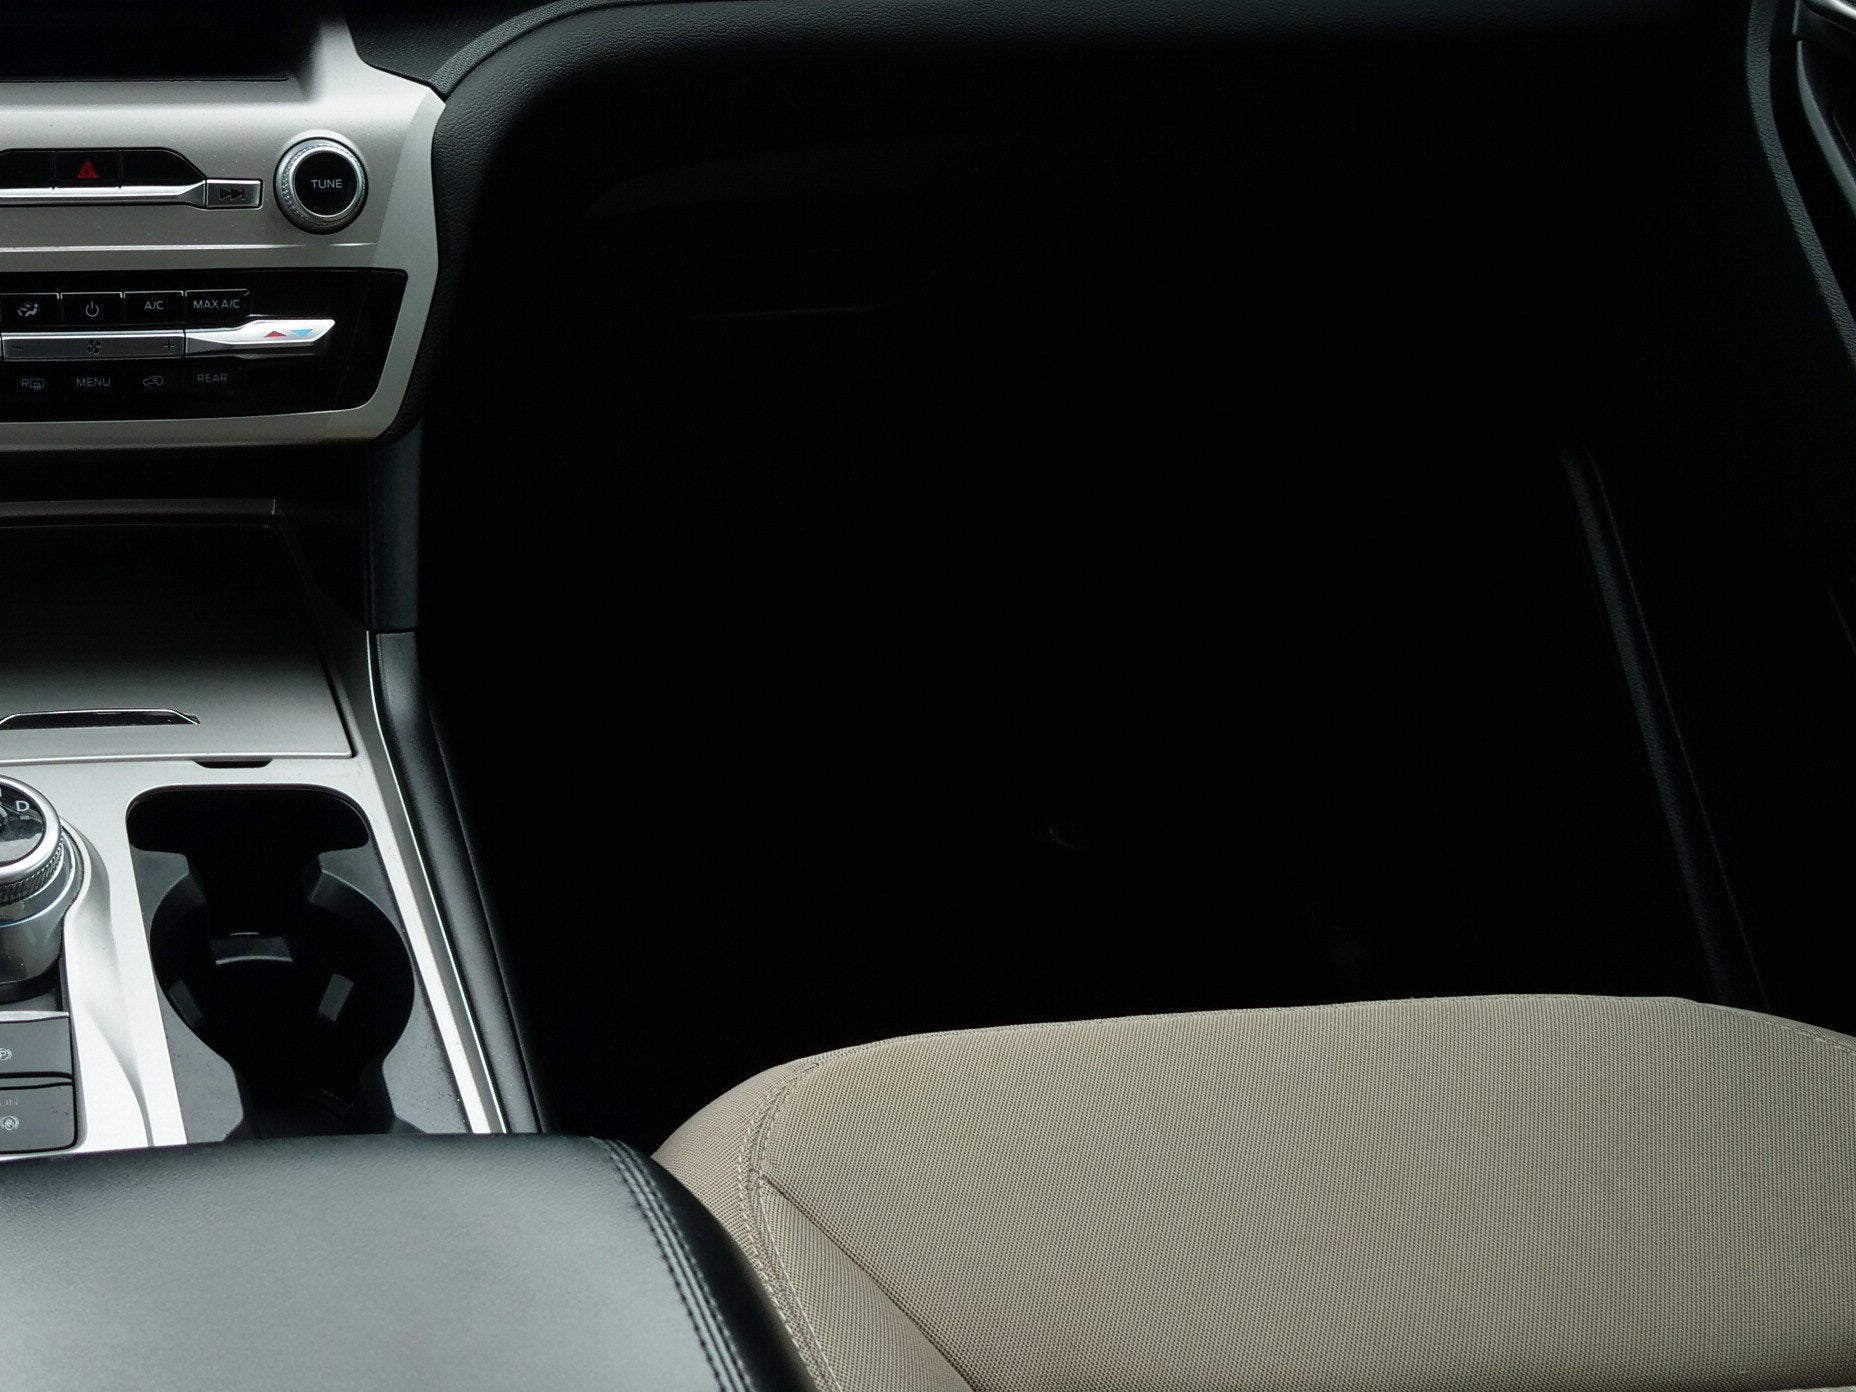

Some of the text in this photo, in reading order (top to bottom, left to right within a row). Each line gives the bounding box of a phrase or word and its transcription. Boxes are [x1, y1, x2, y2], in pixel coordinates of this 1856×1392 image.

[310, 178, 342, 190] TUNE
[144, 300, 165, 311] A/C
[193, 298, 241, 310] MAX A/C
[76, 376, 112, 388] MENU
[196, 372, 229, 384] REAR
[15, 801, 30, 814] D
